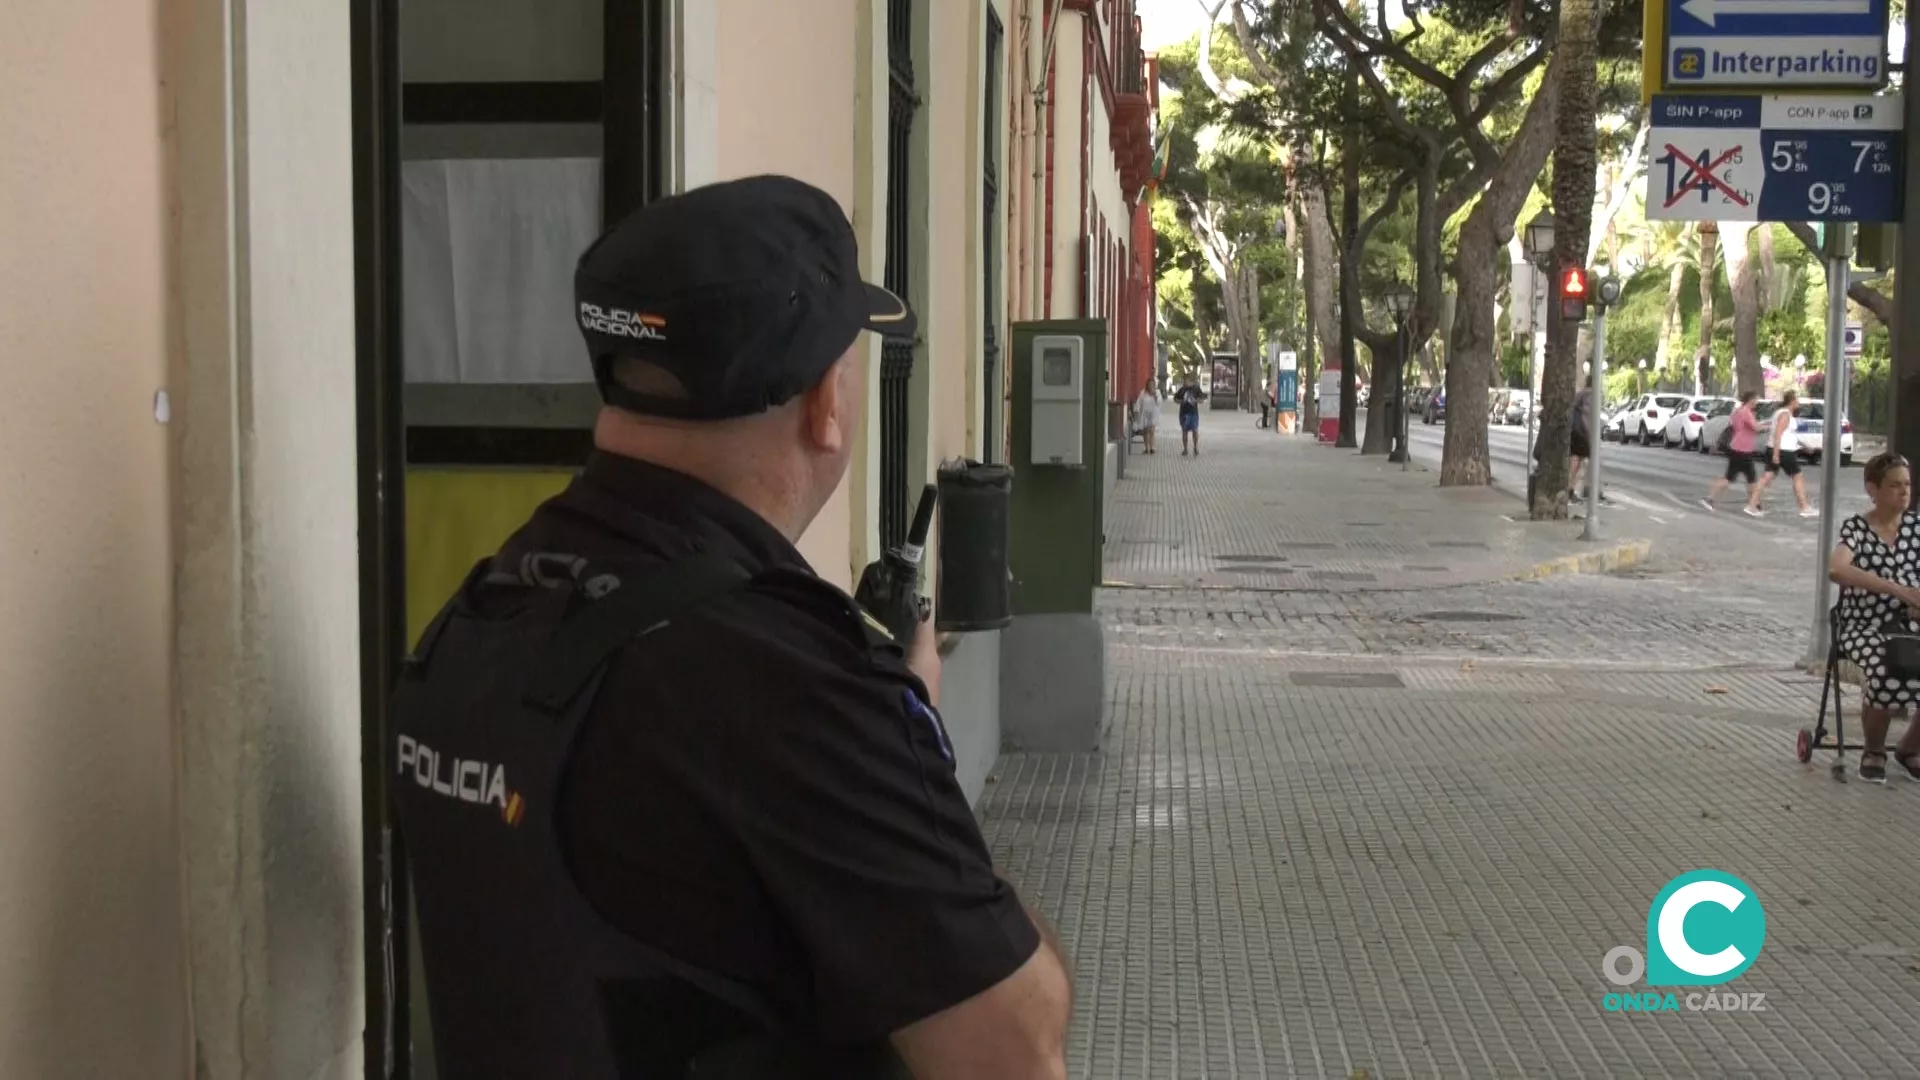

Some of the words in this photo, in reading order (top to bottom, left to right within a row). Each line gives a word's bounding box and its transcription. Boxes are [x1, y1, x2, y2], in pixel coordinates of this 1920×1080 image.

[1712, 49, 1878, 78] Interparking
[1666, 104, 1694, 117] SIN
[1698, 105, 1743, 120] P-app
[1787, 106, 1814, 118] CON
[1817, 107, 1850, 121] P-app
[1771, 141, 1793, 172] 5
[1851, 141, 1872, 173] 7
[1656, 149, 1716, 203] 14
[1808, 183, 1831, 215] 9
[581, 302, 642, 326] POLICIA
[581, 315, 667, 340] NACIONAL
[398, 733, 507, 808] POLICIA
